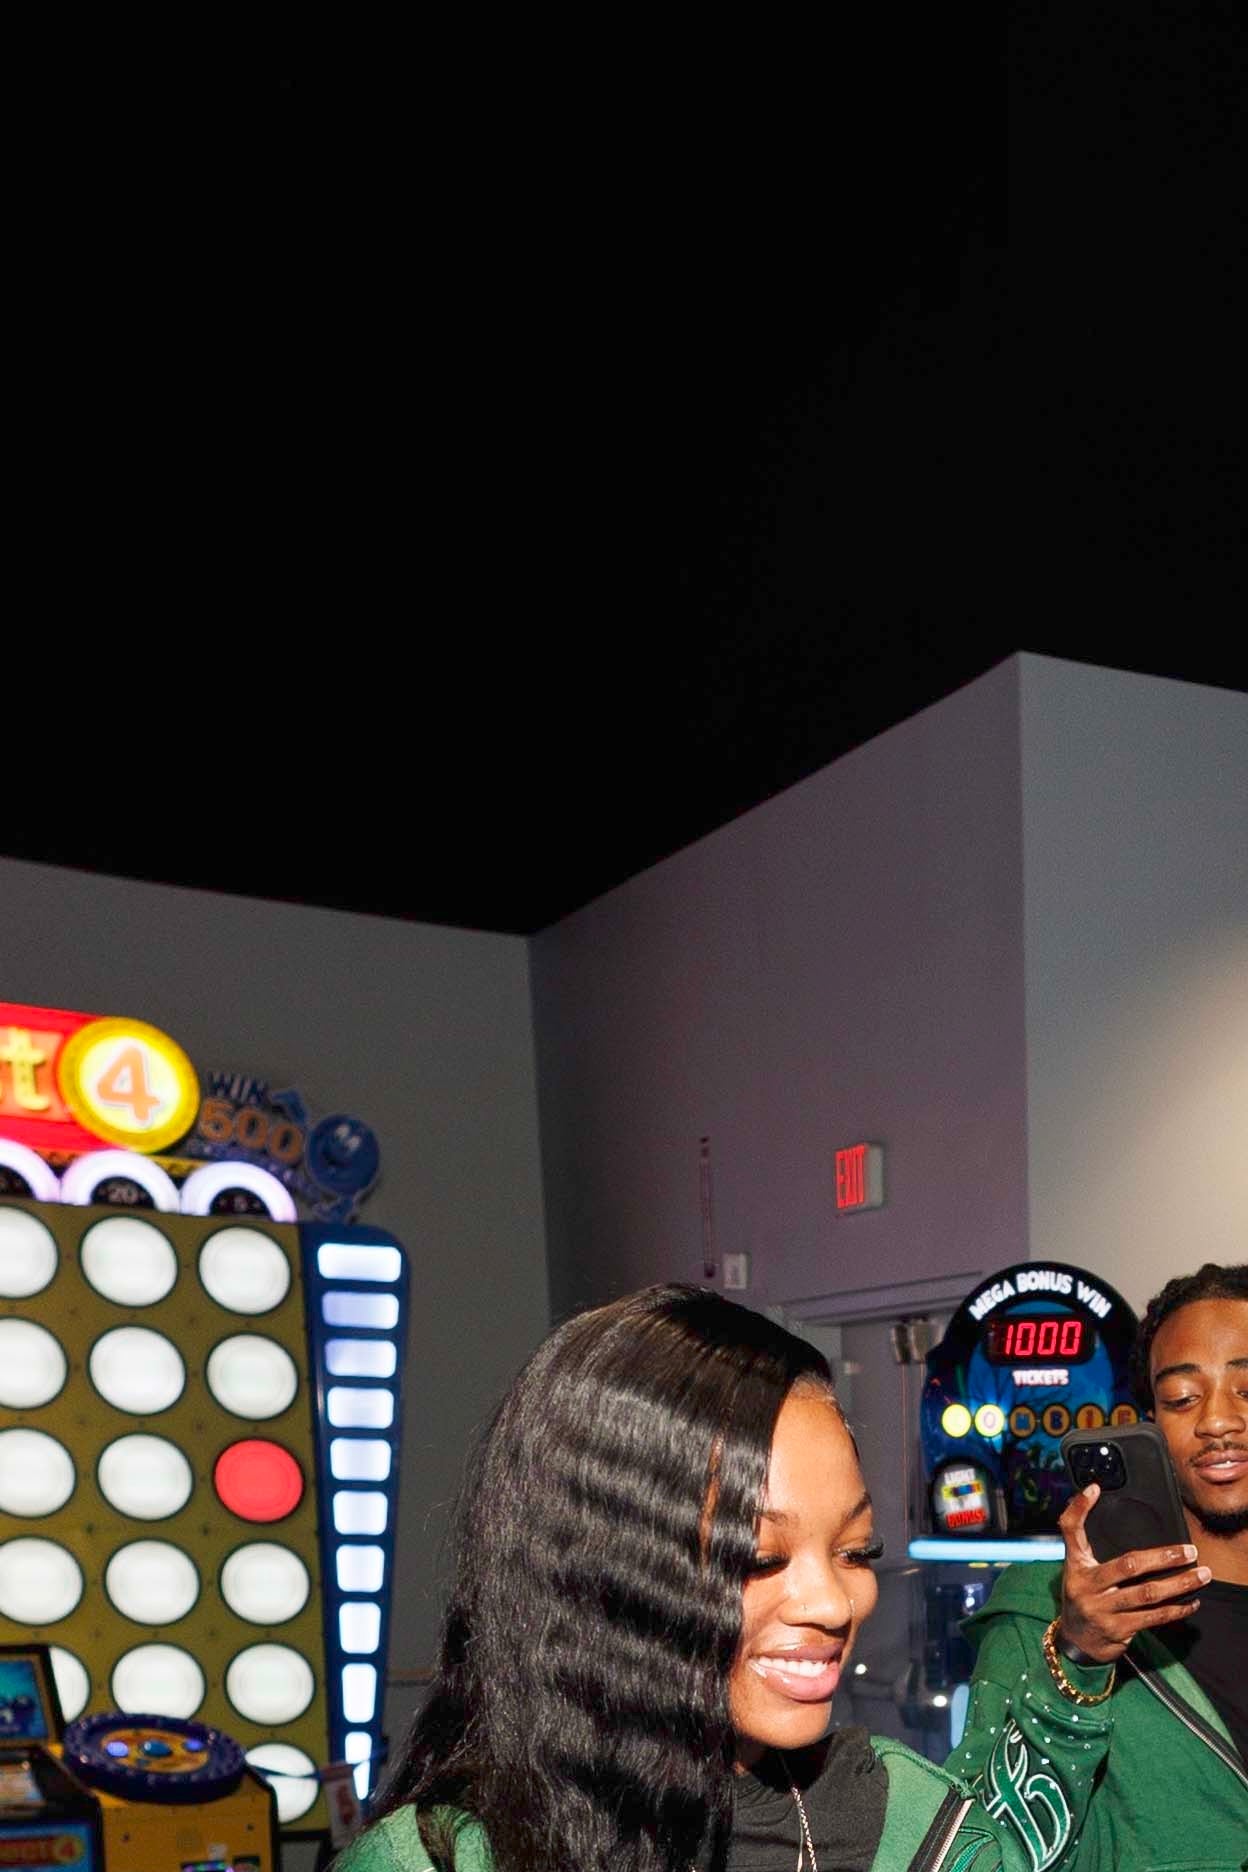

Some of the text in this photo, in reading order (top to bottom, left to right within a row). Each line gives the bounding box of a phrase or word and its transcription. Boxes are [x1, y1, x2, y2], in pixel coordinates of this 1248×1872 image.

[97, 1047, 161, 1121] 4
[201, 1098, 303, 1163] 500
[968, 1270, 1112, 1321] MEGA BONUS WIN
[1004, 1321, 1082, 1356] 1000
[1012, 1369, 1069, 1387] TICKETS
